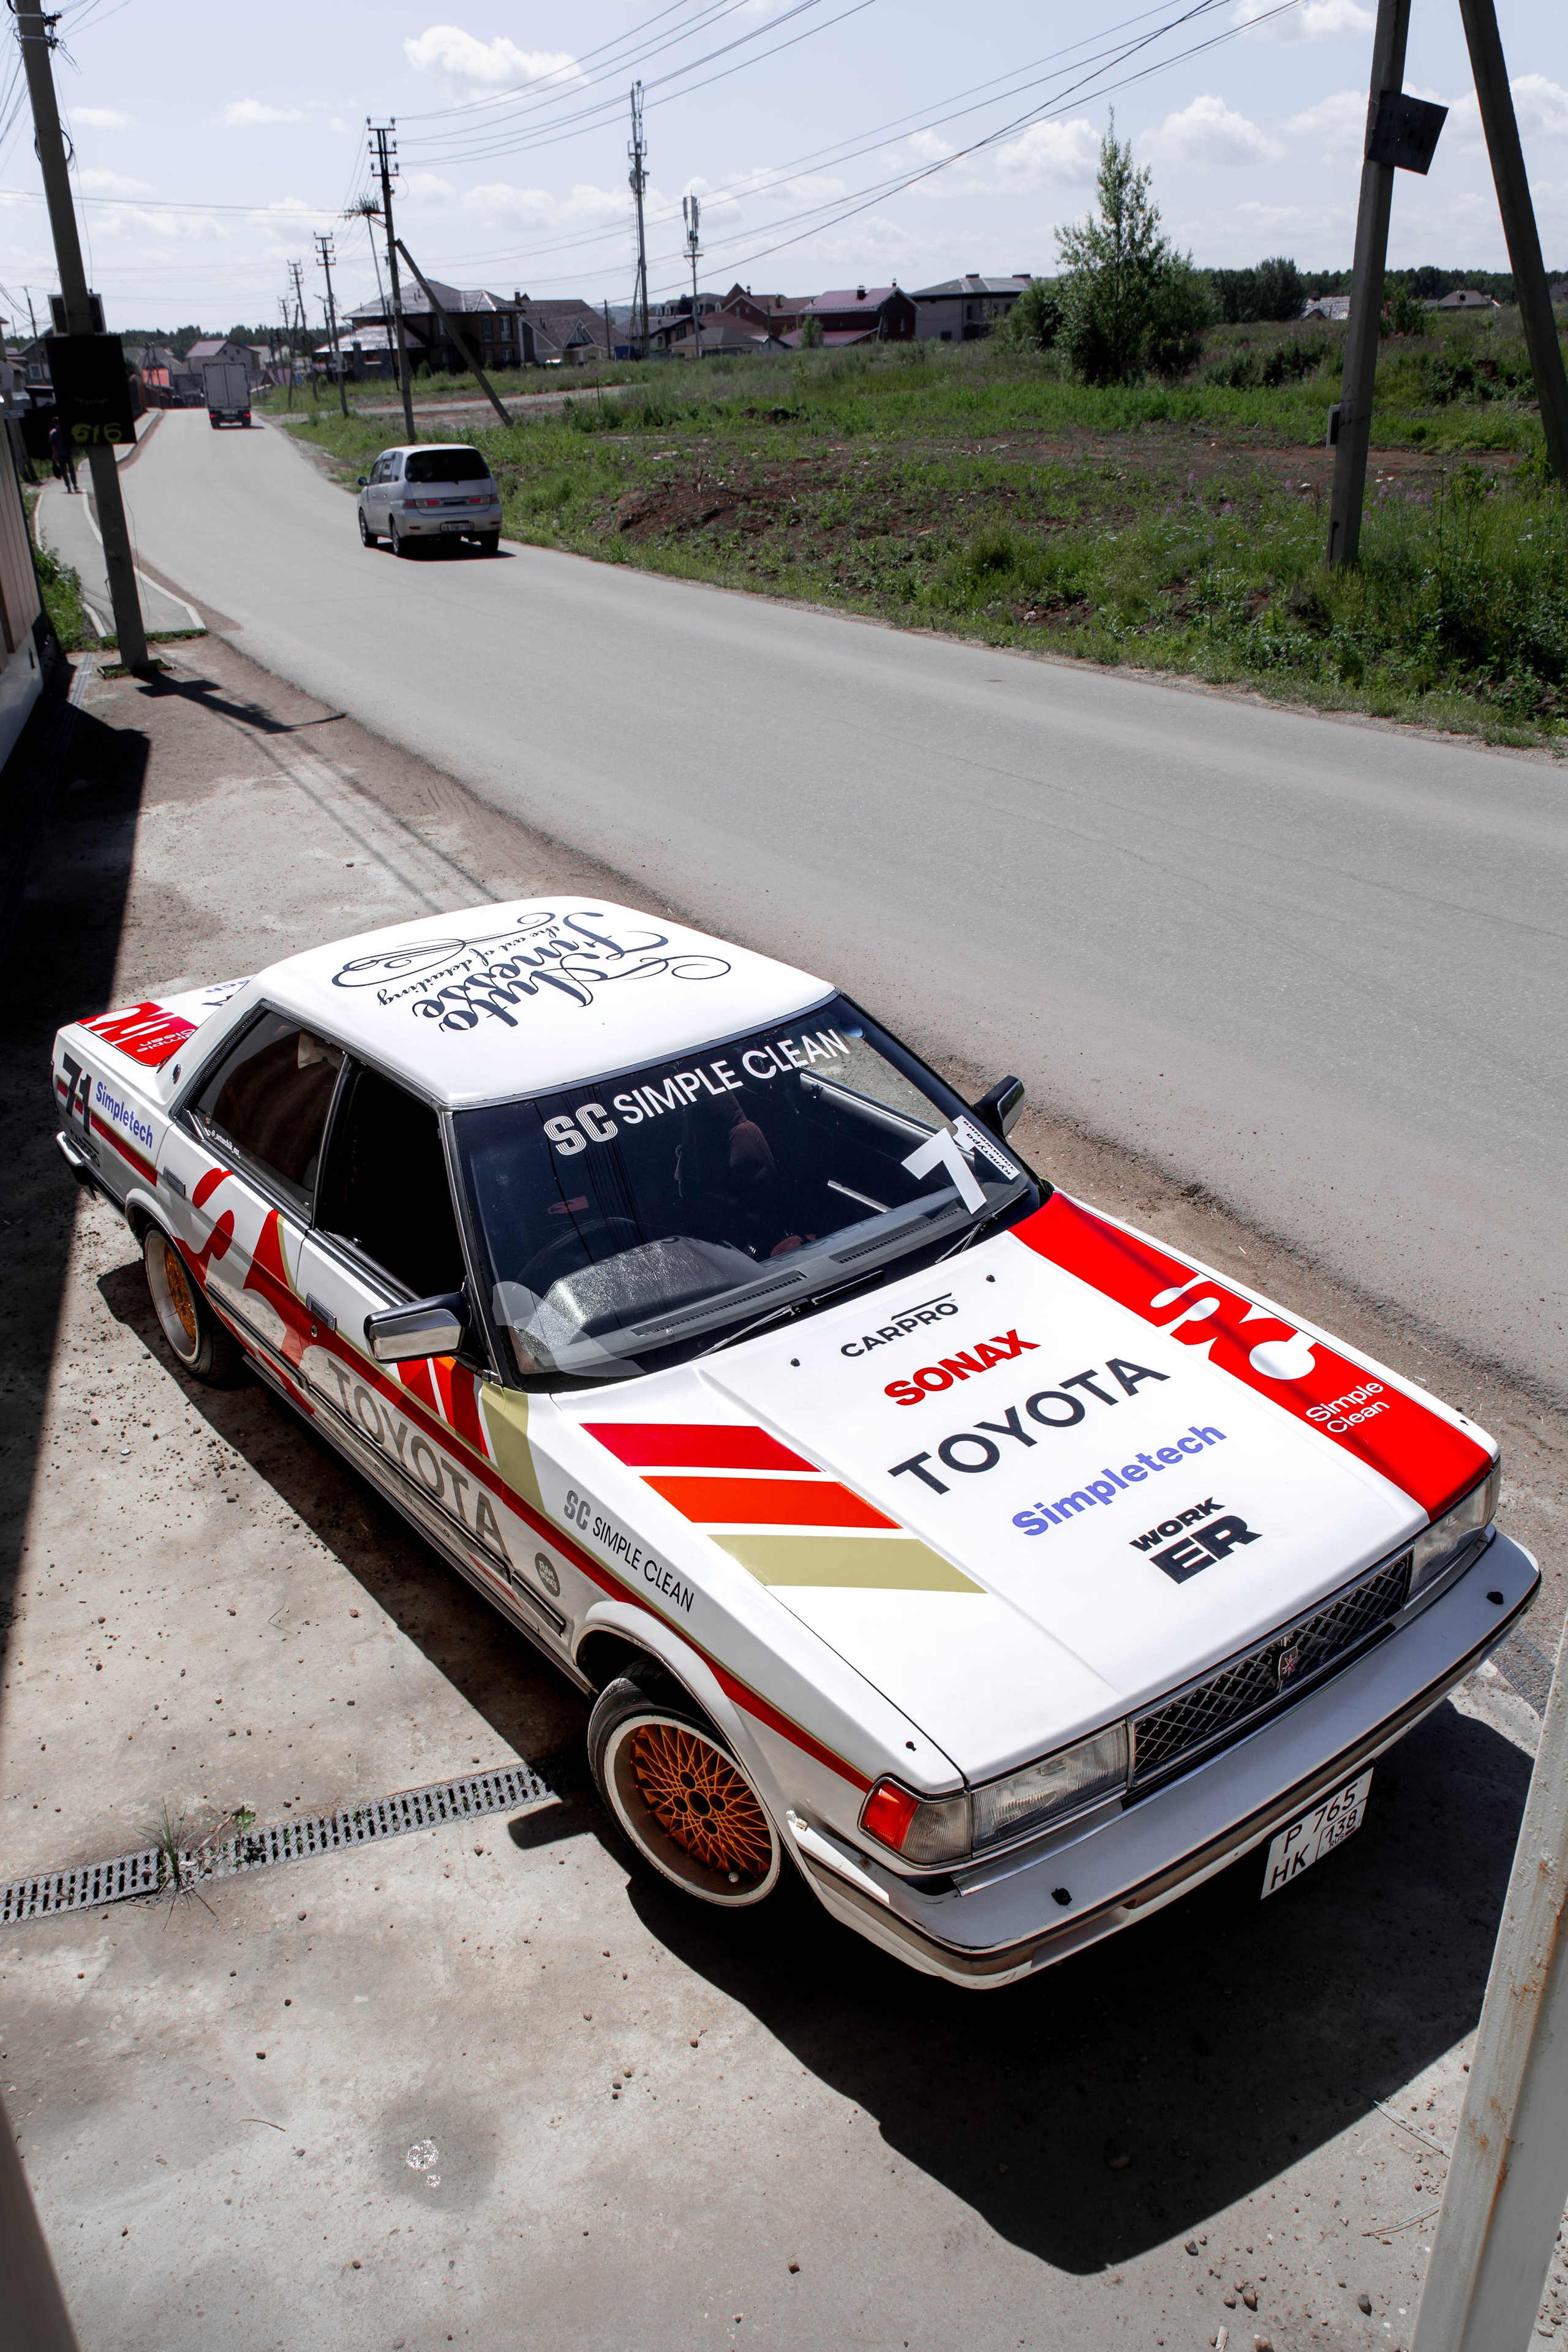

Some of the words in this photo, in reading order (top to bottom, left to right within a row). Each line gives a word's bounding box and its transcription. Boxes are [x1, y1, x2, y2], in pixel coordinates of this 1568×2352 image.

[468, 947, 494, 965] of
[498, 936, 526, 954] art
[529, 925, 560, 941] the
[379, 959, 472, 1008] detailing
[61, 1051, 92, 1137] 71
[96, 1081, 153, 1149] Simpletech
[543, 1102, 619, 1155] SC
[613, 1059, 744, 1125] SIMPLE
[742, 1028, 850, 1080] CLEAN
[965, 1133, 1011, 1175] культура
[840, 1293, 959, 1358] CARPRO
[884, 1329, 1041, 1406] SONAX
[887, 1357, 1171, 1495] TOYOTA
[1305, 1382, 1384, 1422] Simple
[1327, 1400, 1390, 1433] Clean
[328, 1359, 513, 1572] TOYOTA
[1011, 1423, 1227, 1536] Simpletech
[564, 1490, 591, 1531] SC
[592, 1517, 643, 1570] SIMPLE
[644, 1559, 695, 1613] CLEAN
[1128, 1496, 1227, 1552] WORK
[1149, 1515, 1263, 1584] ER
[1313, 1782, 1358, 1834] 765
[1325, 1809, 1357, 1844] 138
[1329, 1833, 1345, 1849] RUS
